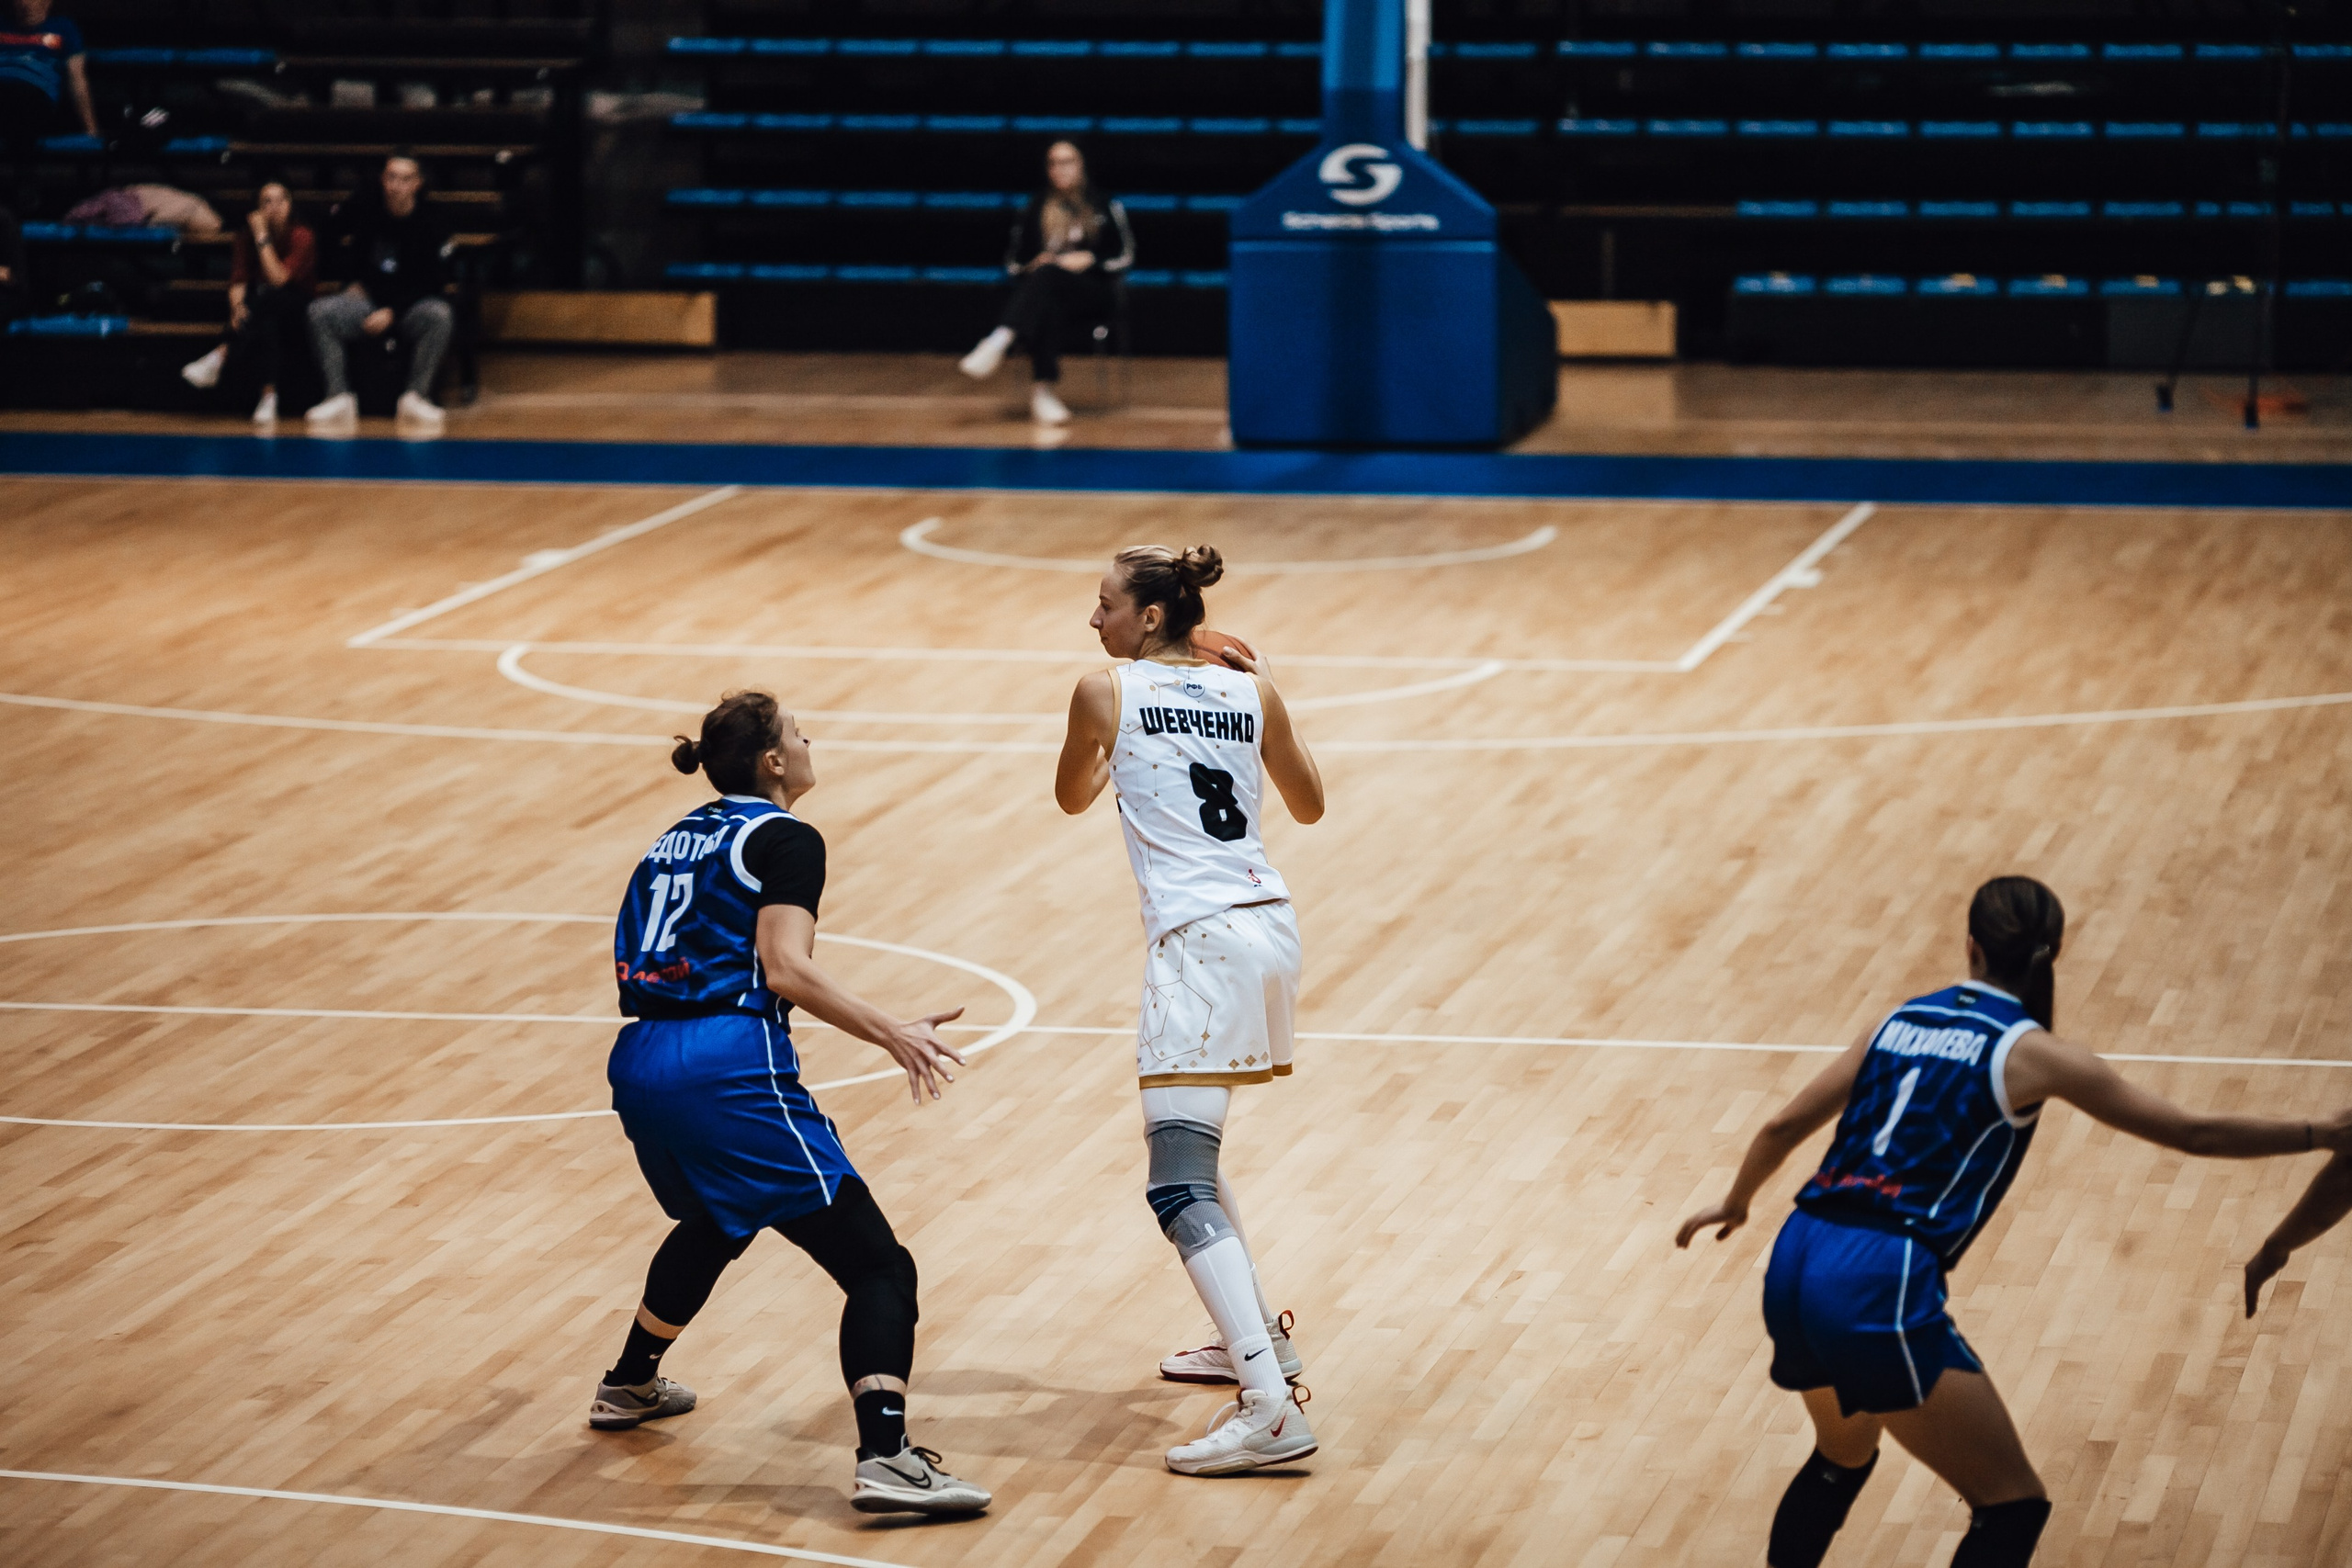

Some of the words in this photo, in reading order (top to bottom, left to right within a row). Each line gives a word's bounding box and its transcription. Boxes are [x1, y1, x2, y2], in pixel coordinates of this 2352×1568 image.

[1139, 706, 1254, 744] ШЕВЧЕНКО
[1189, 761, 1248, 842] 8
[640, 873, 694, 952] 12
[1872, 1066, 1921, 1156] 1
